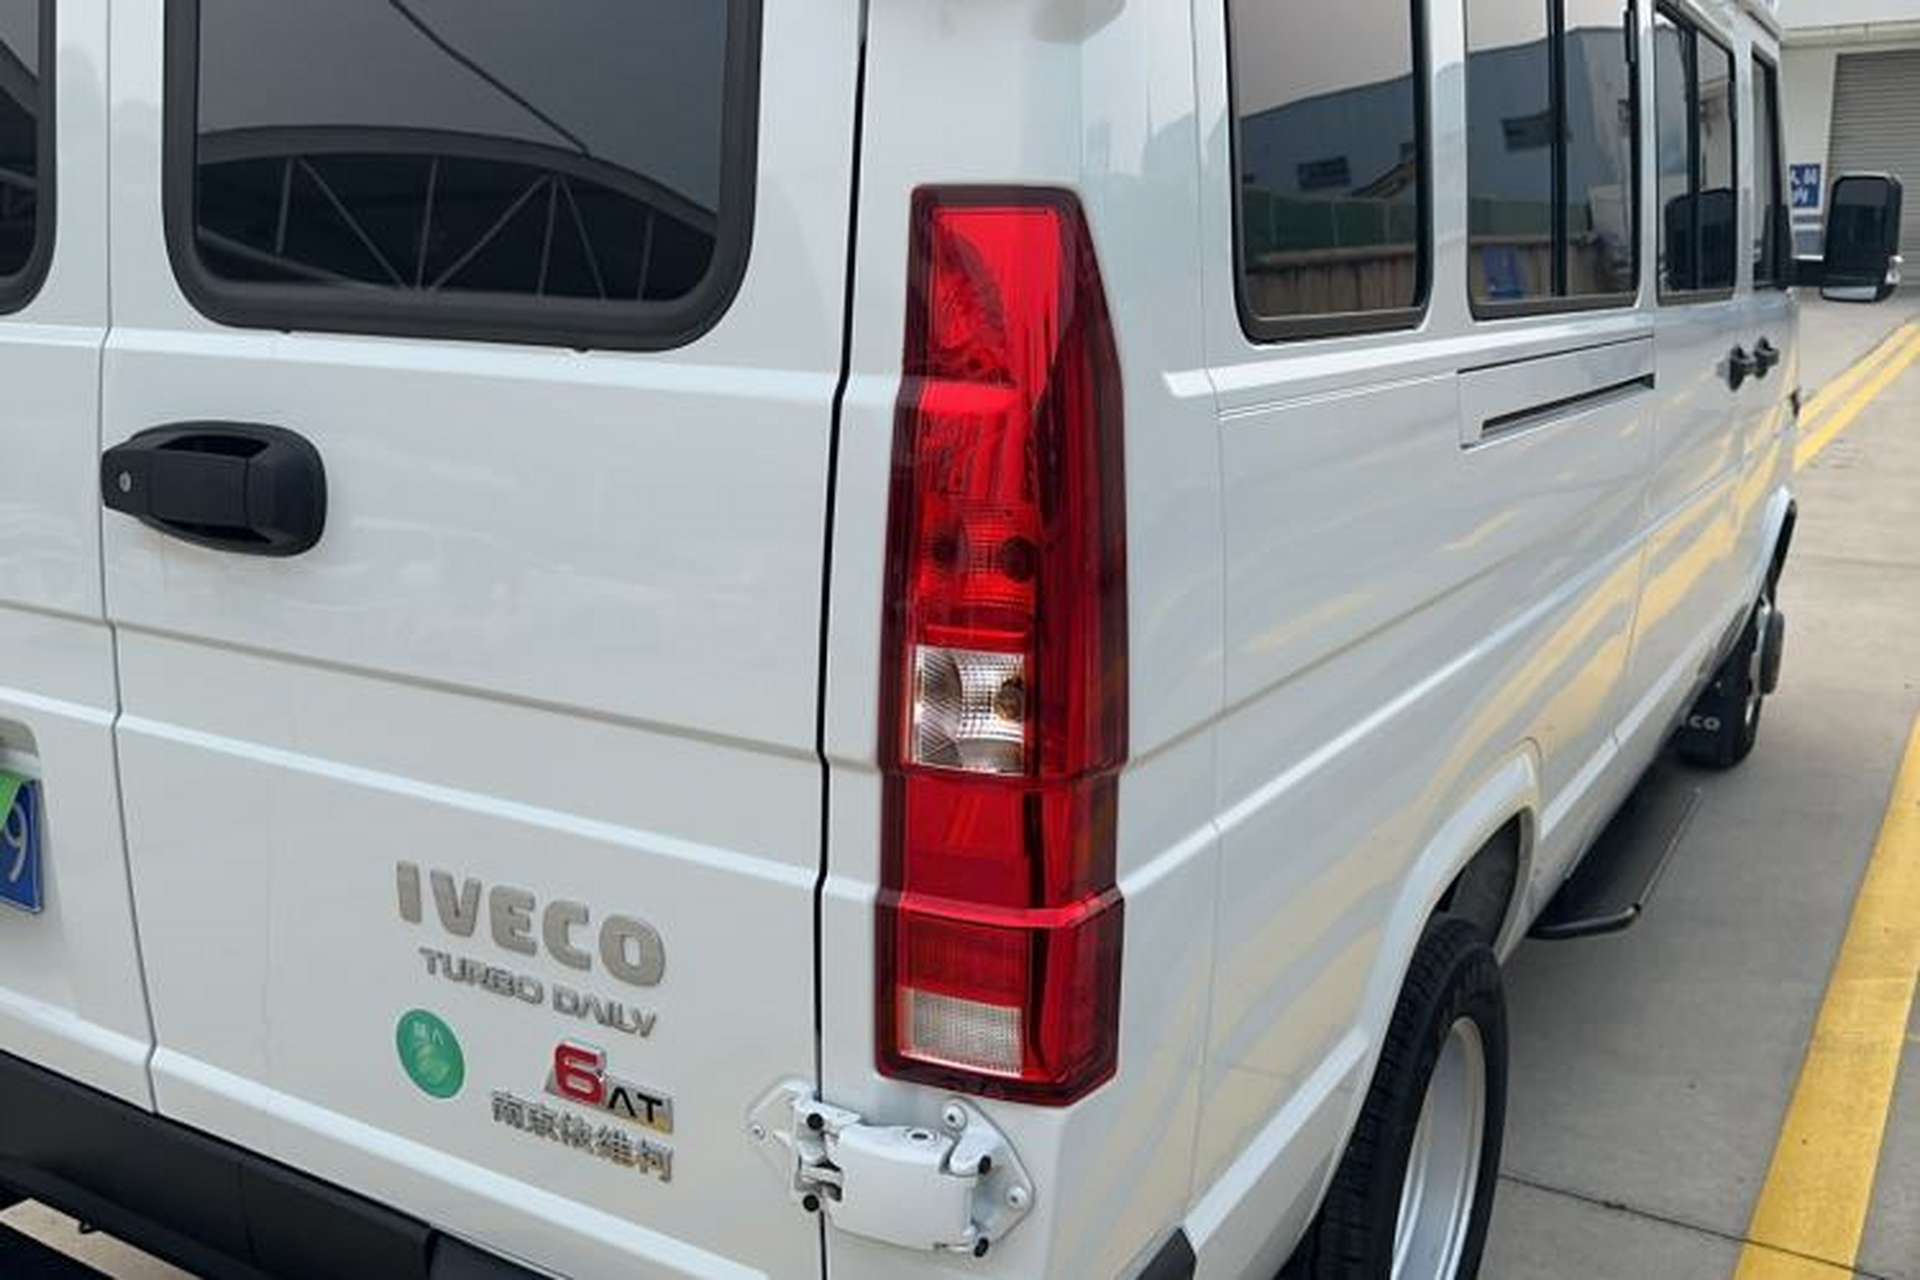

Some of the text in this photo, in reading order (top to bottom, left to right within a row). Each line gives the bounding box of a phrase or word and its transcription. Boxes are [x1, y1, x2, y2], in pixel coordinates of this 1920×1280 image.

[396, 861, 666, 987] IVECO
[418, 947, 657, 1037] TURBO DAILY
